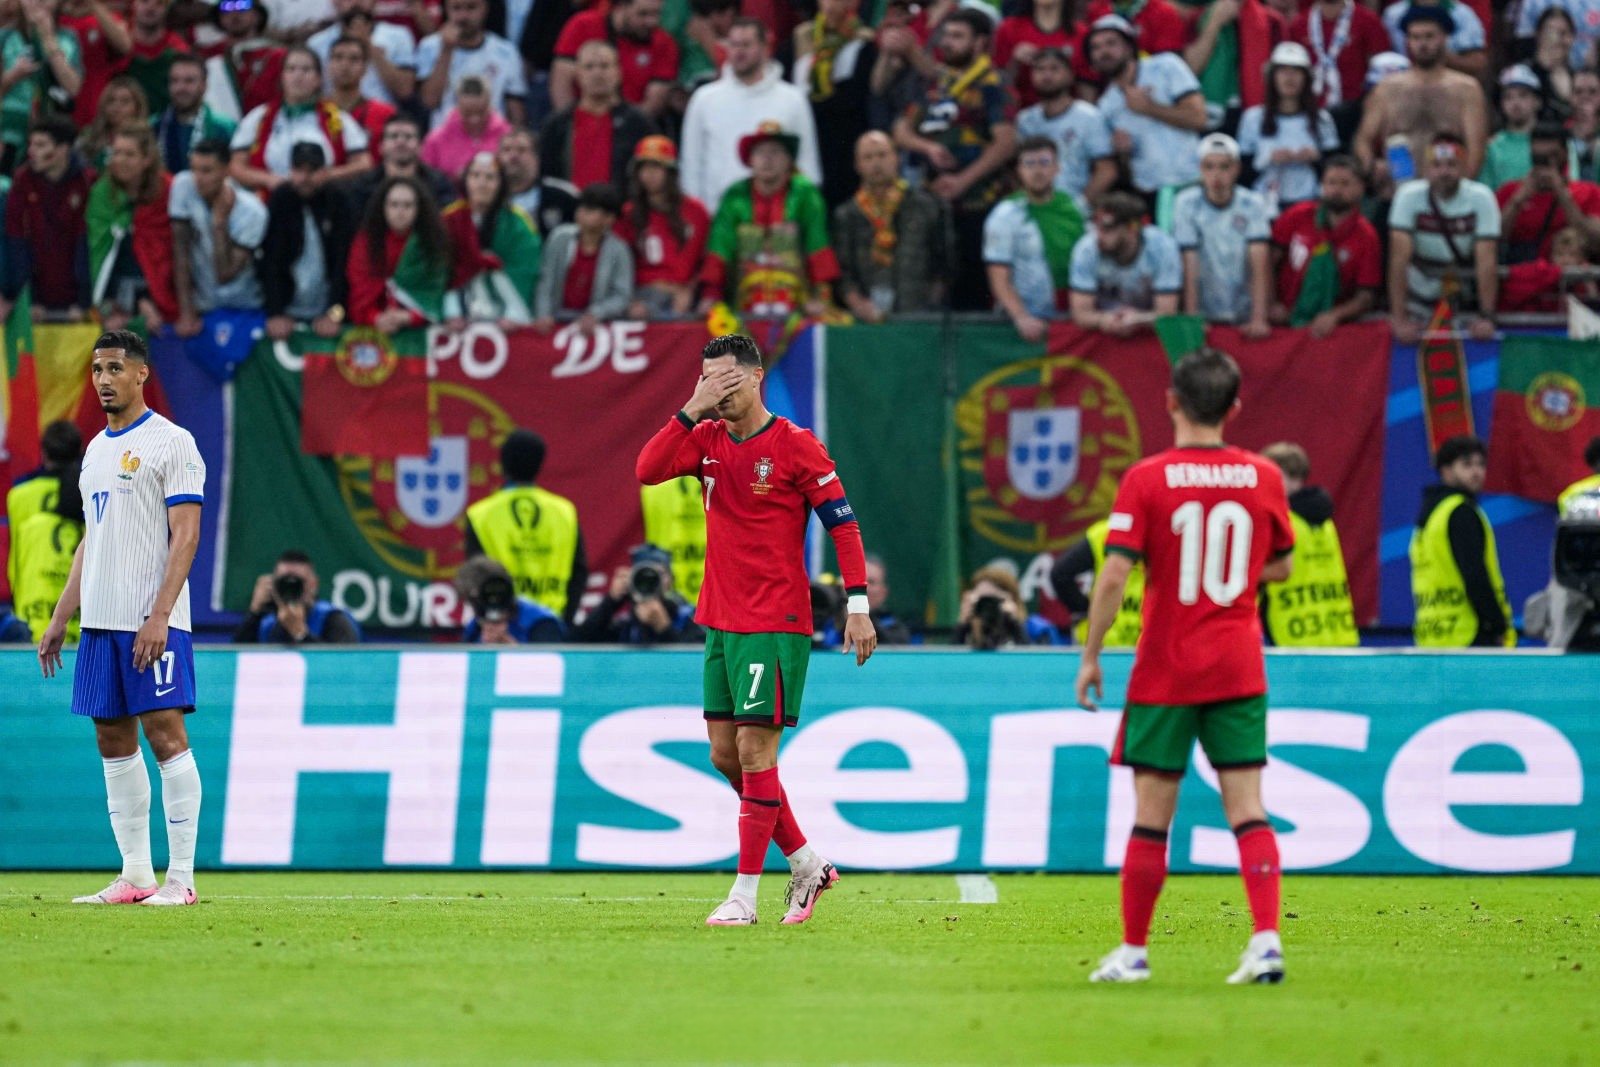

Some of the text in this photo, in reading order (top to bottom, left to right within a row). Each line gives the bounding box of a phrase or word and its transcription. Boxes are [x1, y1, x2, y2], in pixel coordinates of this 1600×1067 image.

[551, 321, 648, 378] DE
[703, 475, 716, 511] 7
[1165, 463, 1258, 489] BERNARDO
[92, 491, 109, 524] 17
[1171, 500, 1253, 607] 10
[149, 651, 175, 685] 17
[749, 663, 765, 699] 7
[221, 652, 1583, 871] Hisense
